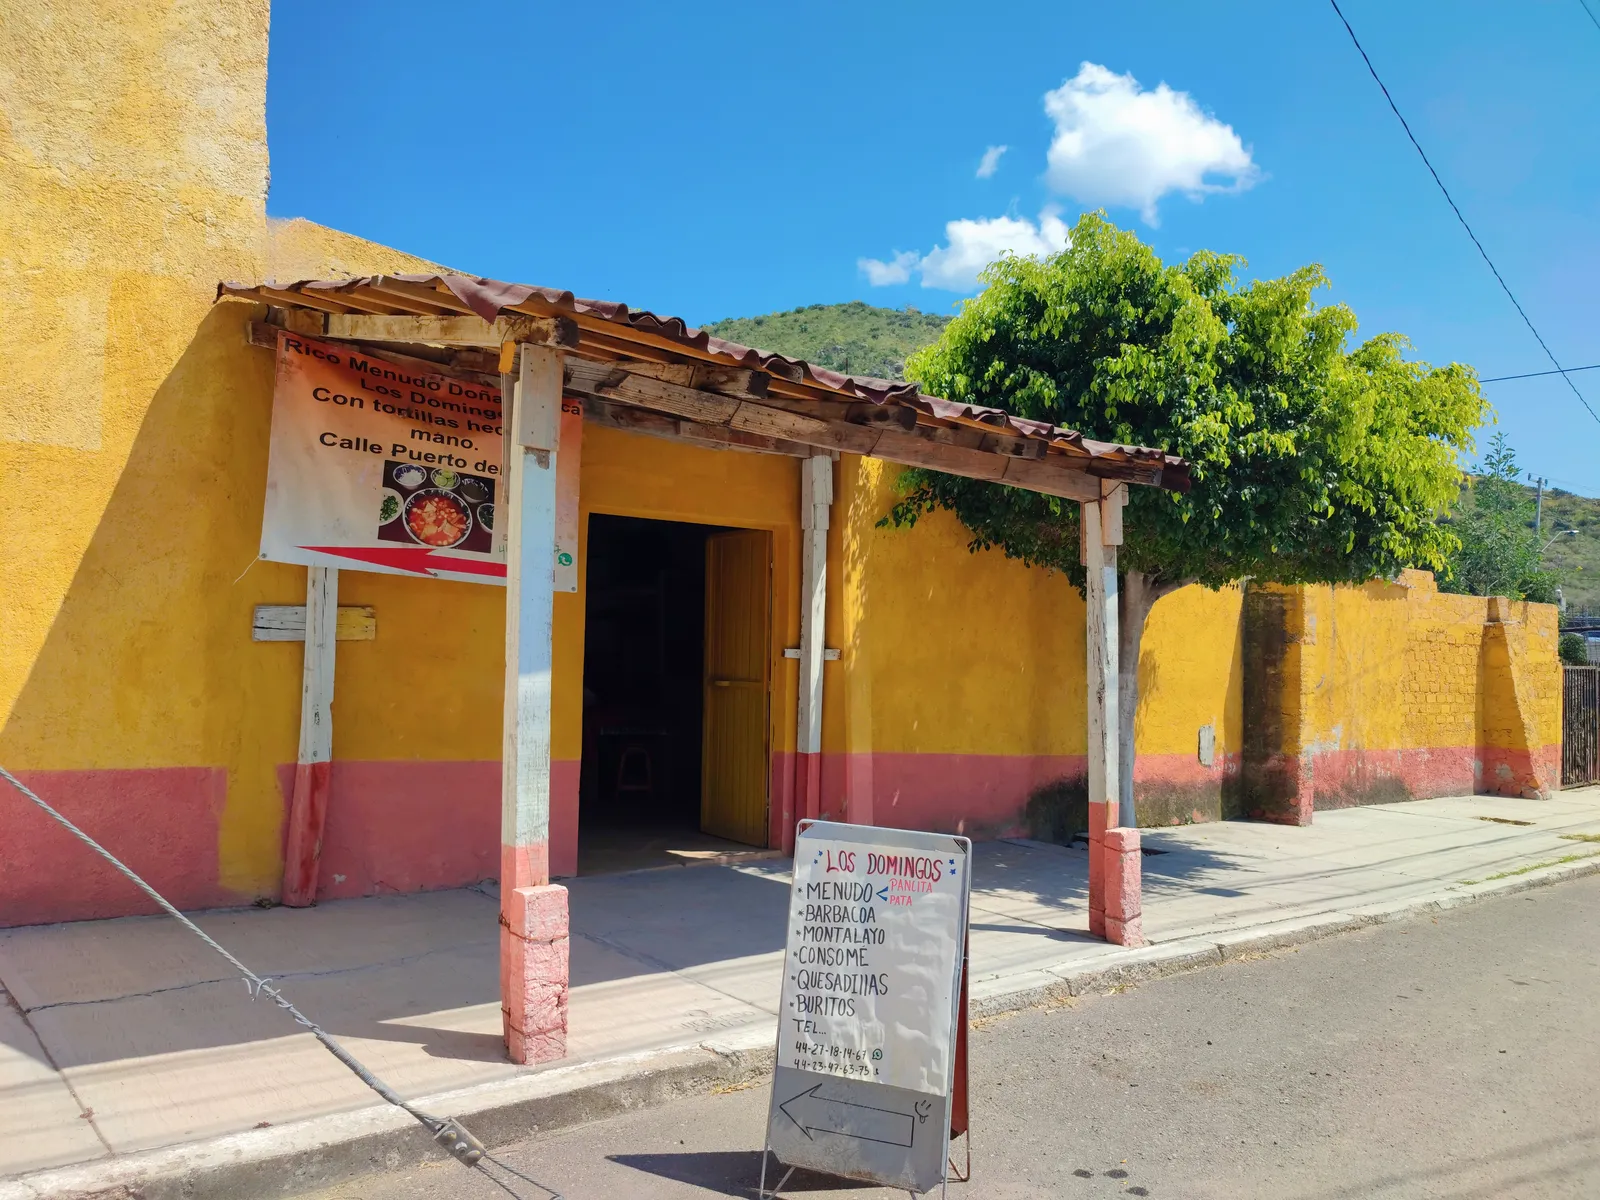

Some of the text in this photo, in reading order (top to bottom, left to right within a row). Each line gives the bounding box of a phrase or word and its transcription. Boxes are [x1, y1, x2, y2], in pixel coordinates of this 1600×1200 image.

[284, 338, 502, 404] Rico Menudo Doña
[361, 378, 402, 399] Los
[312, 387, 502, 436] Con tortillas hec
[319, 432, 383, 454] Calle
[391, 443, 467, 469] Puerto
[410, 428, 479, 451] mano.
[826, 850, 943, 882] LOS DOMINGOS
[806, 882, 873, 902] MENUDO
[889, 878, 933, 893] PANCITA
[889, 895, 913, 907] PATA
[805, 904, 876, 923] BARBACOA
[803, 926, 885, 945] MONTALAYO
[796, 994, 855, 1017] BURITOS
